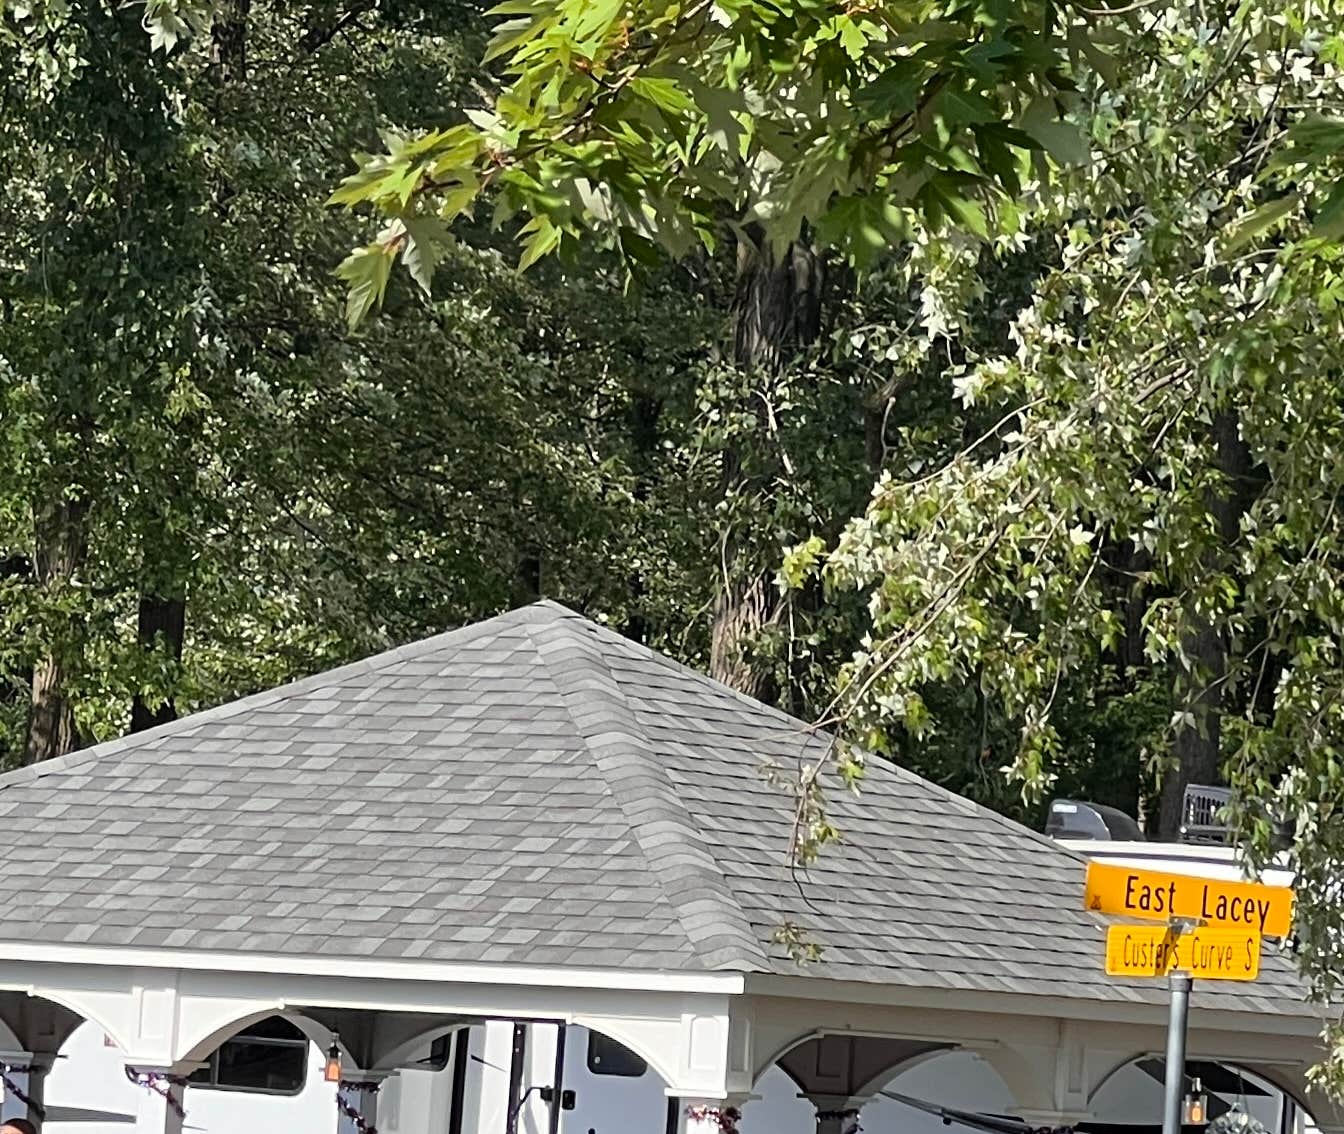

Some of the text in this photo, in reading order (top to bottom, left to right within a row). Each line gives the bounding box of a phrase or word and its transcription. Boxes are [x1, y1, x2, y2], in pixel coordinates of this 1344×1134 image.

[1125, 875, 1271, 933] East Lacey
[1191, 936, 1233, 971] Curve
[1244, 937, 1254, 972] S
